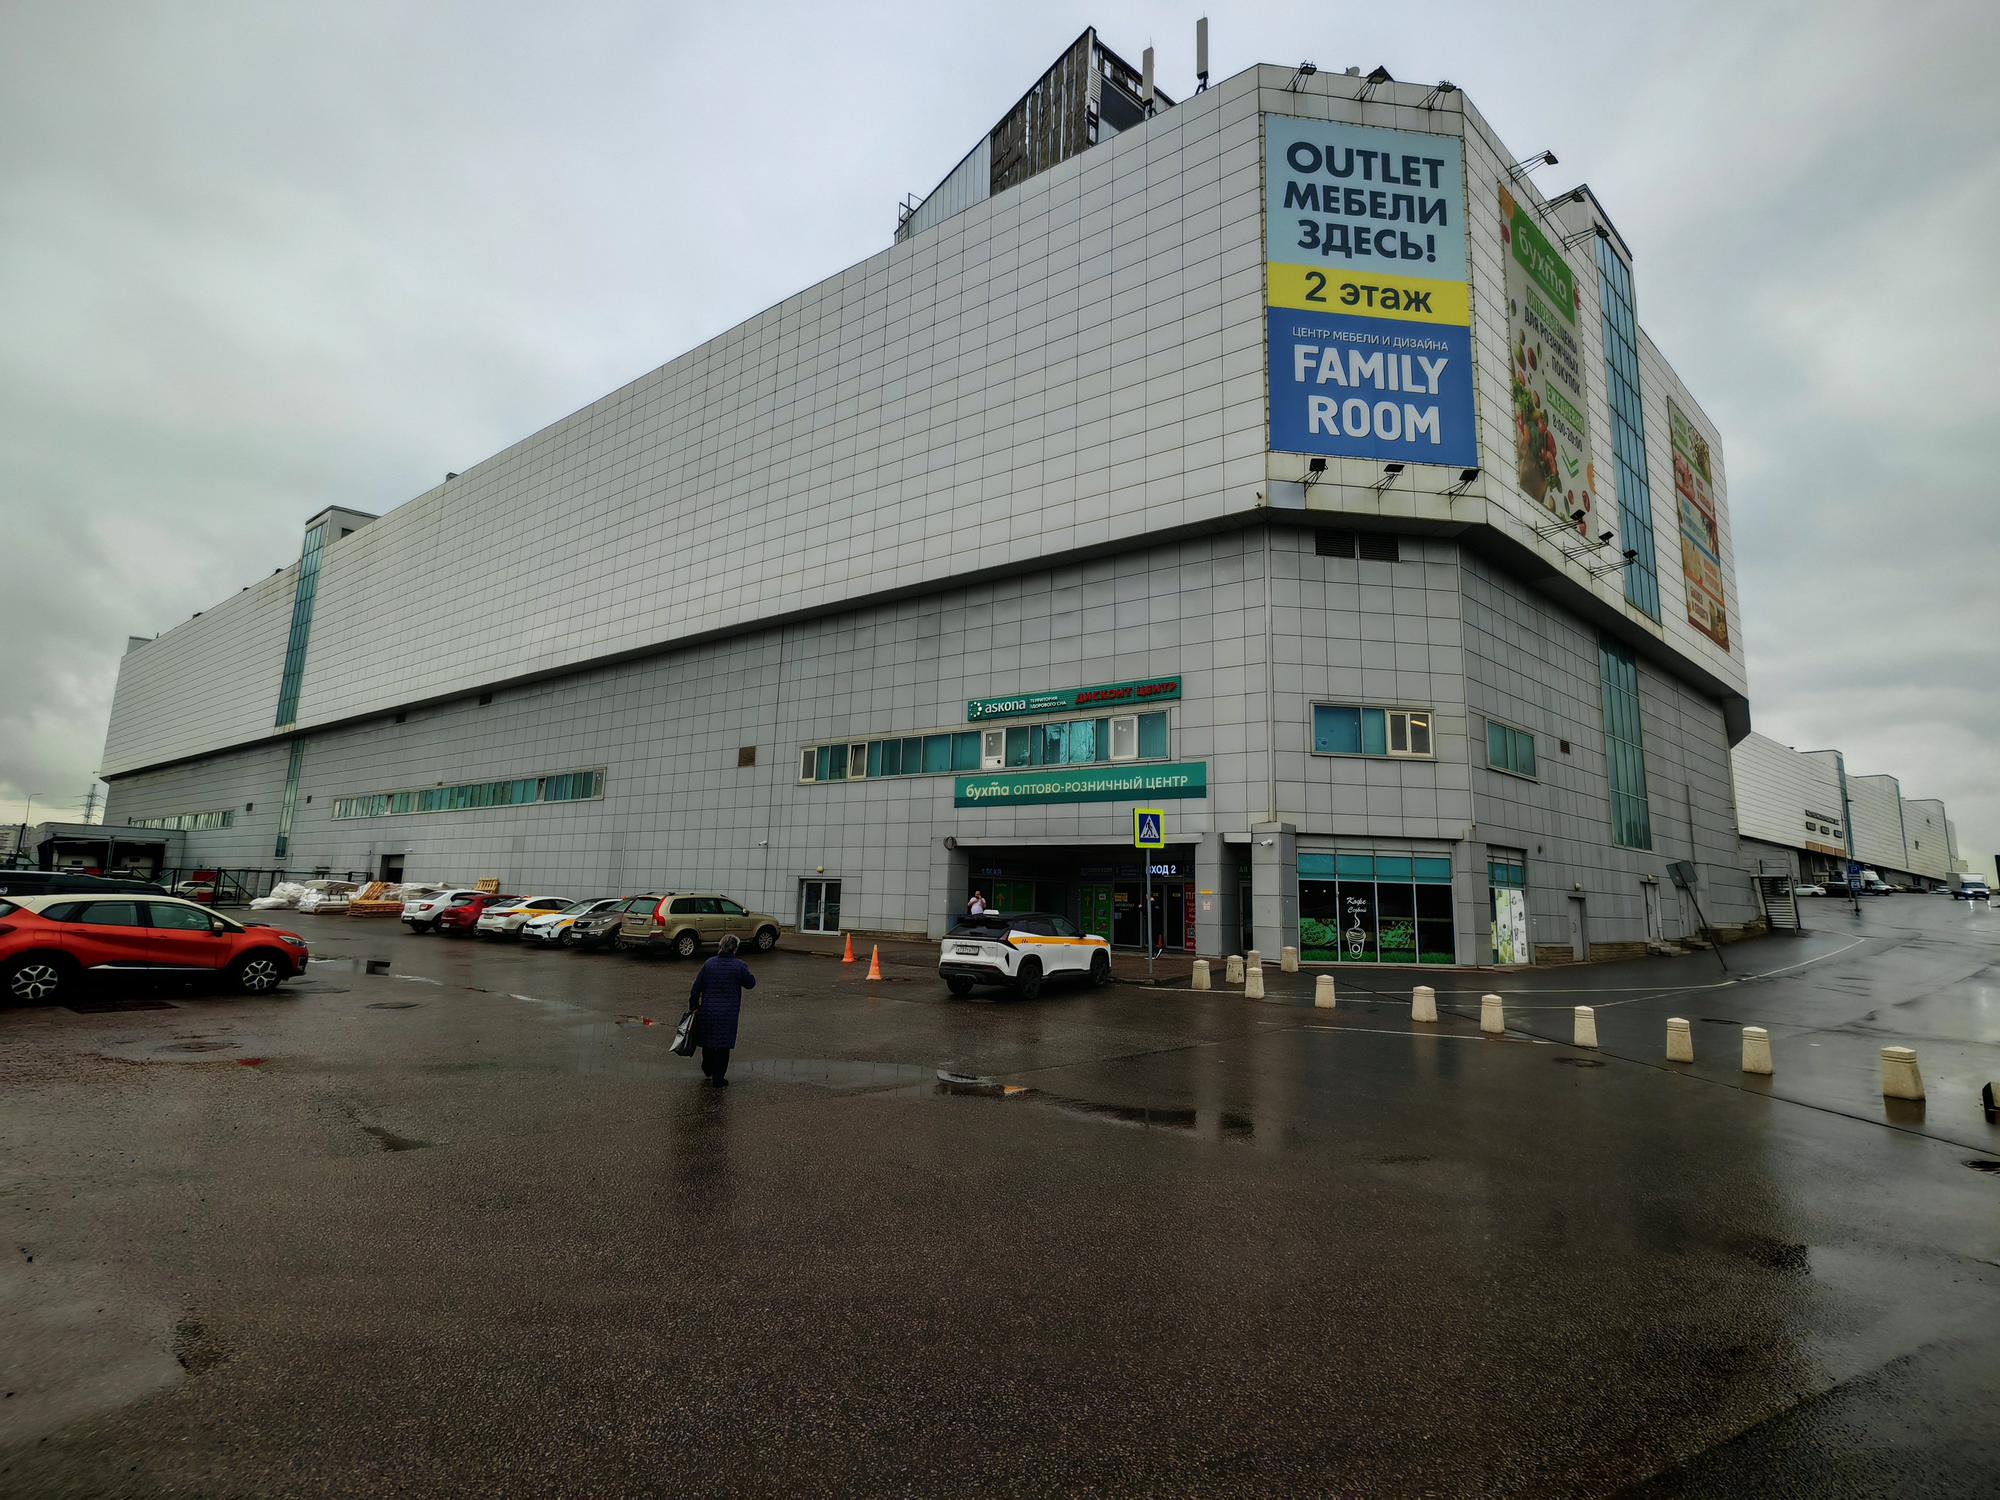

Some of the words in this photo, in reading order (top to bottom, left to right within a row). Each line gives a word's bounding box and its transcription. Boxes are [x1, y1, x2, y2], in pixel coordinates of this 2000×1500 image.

[1286, 141, 1445, 189] OUTLET
[1283, 181, 1448, 227] МЕБЕЛИ
[1297, 219, 1437, 263] ЗДЕСЬ!
[1305, 271, 1327, 302] 2
[1339, 282, 1433, 314] этаж
[1525, 305, 1539, 335] ДЛЯ
[1292, 326, 1331, 340] ЦЕНТР
[1332, 330, 1380, 345] МЕБЕЛИ
[1382, 336, 1391, 346] И
[1393, 335, 1449, 351] ДИЗАЙНА
[1293, 344, 1450, 396] FAMILY
[1308, 395, 1441, 445] ROOM
[984, 698, 1026, 714] askona
[1075, 687, 1132, 705] ДИСКОНТ
[1136, 681, 1177, 698] ЦЕНТР
[966, 781, 1009, 800] бухта
[1013, 775, 1143, 796] ОПТОВО-РОЗНИЧНЫЙ
[1146, 775, 1188, 790] ЦЕНТР
[1170, 864, 1177, 874] 2
